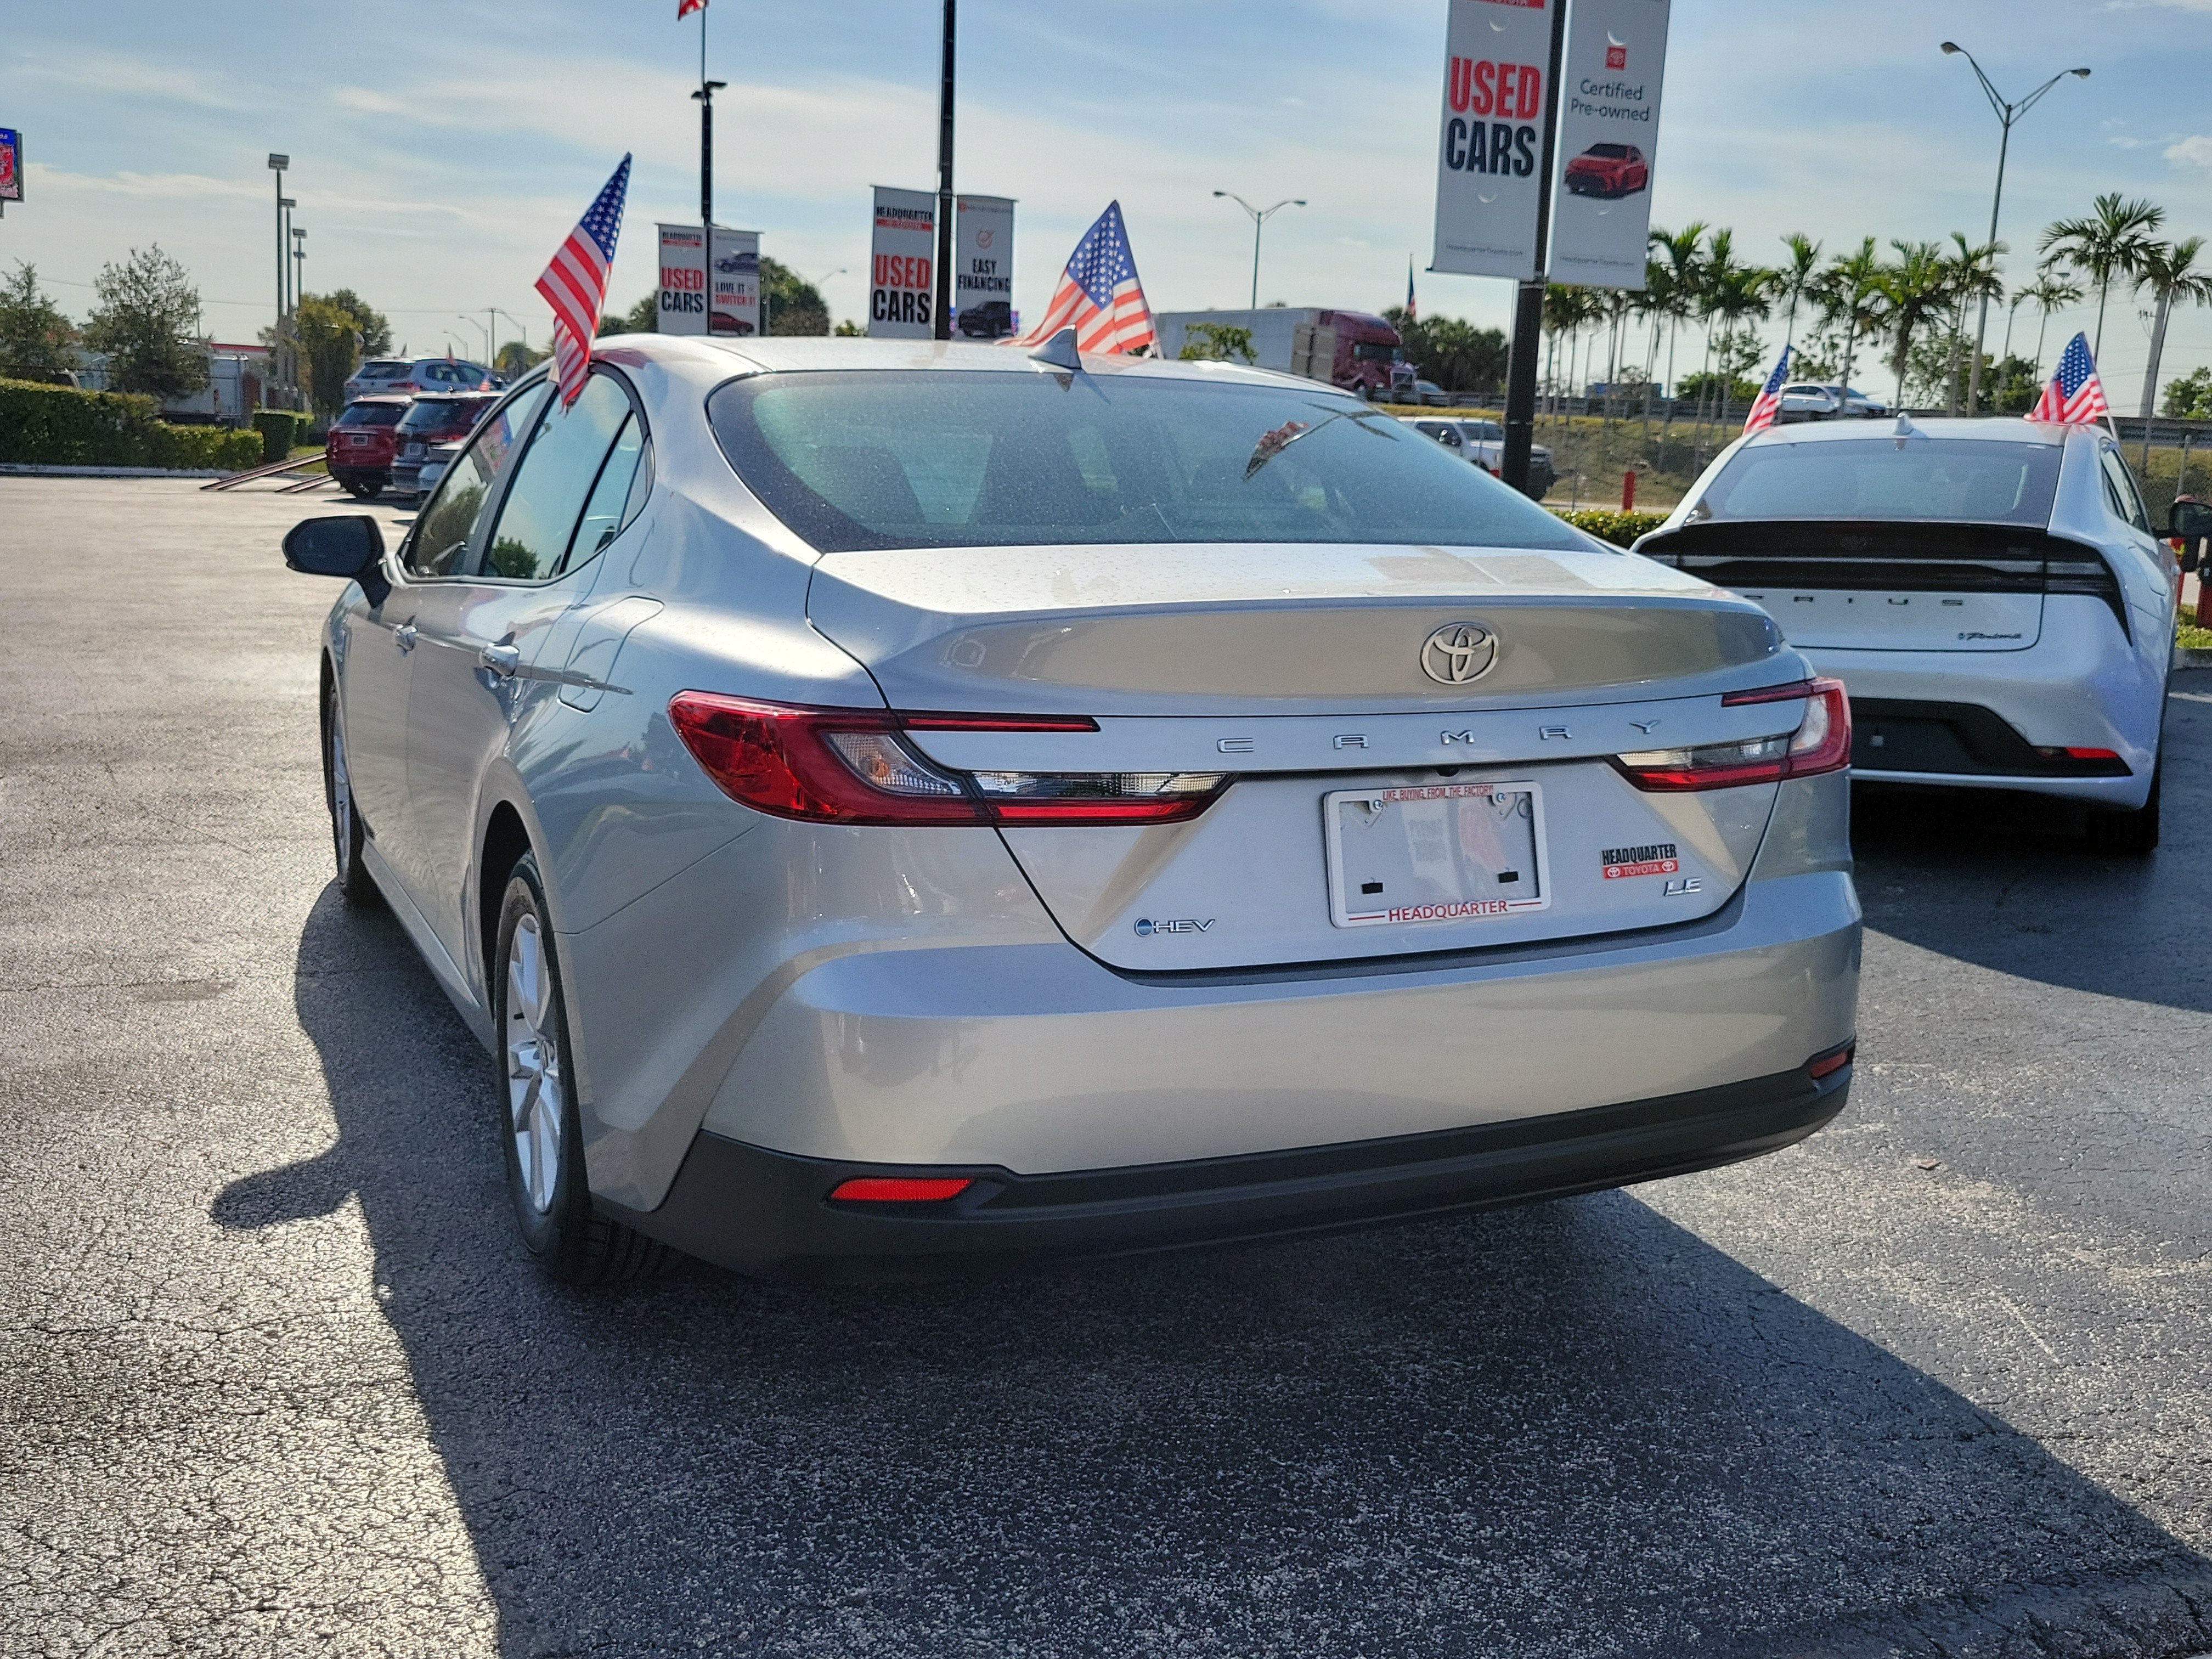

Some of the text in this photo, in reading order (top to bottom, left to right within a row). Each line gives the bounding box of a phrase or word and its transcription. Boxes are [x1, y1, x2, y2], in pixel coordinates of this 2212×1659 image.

[1449, 57, 1541, 120] USED
[1580, 78, 1643, 100] Certified
[1571, 98, 1650, 121] Pre-owned
[1446, 118, 1536, 178] CARS
[875, 253, 931, 290] USED
[973, 258, 997, 274] EASY
[662, 267, 703, 291] USED
[662, 291, 704, 313] CARS
[873, 289, 932, 324] CARS
[1217, 719, 1661, 754] CAMRY
[1383, 790, 1397, 801] LIKE
[1400, 788, 1424, 800] BUYING
[1427, 787, 1446, 798] FROM
[1448, 786, 1461, 797] THE
[1602, 843, 1677, 865] HEADQUARTER
[1623, 865, 1660, 876] TOYOTA
[1663, 877, 1702, 896] LE
[1388, 900, 1508, 922] HEADQUARTER
[1153, 918, 1216, 934] HEV
